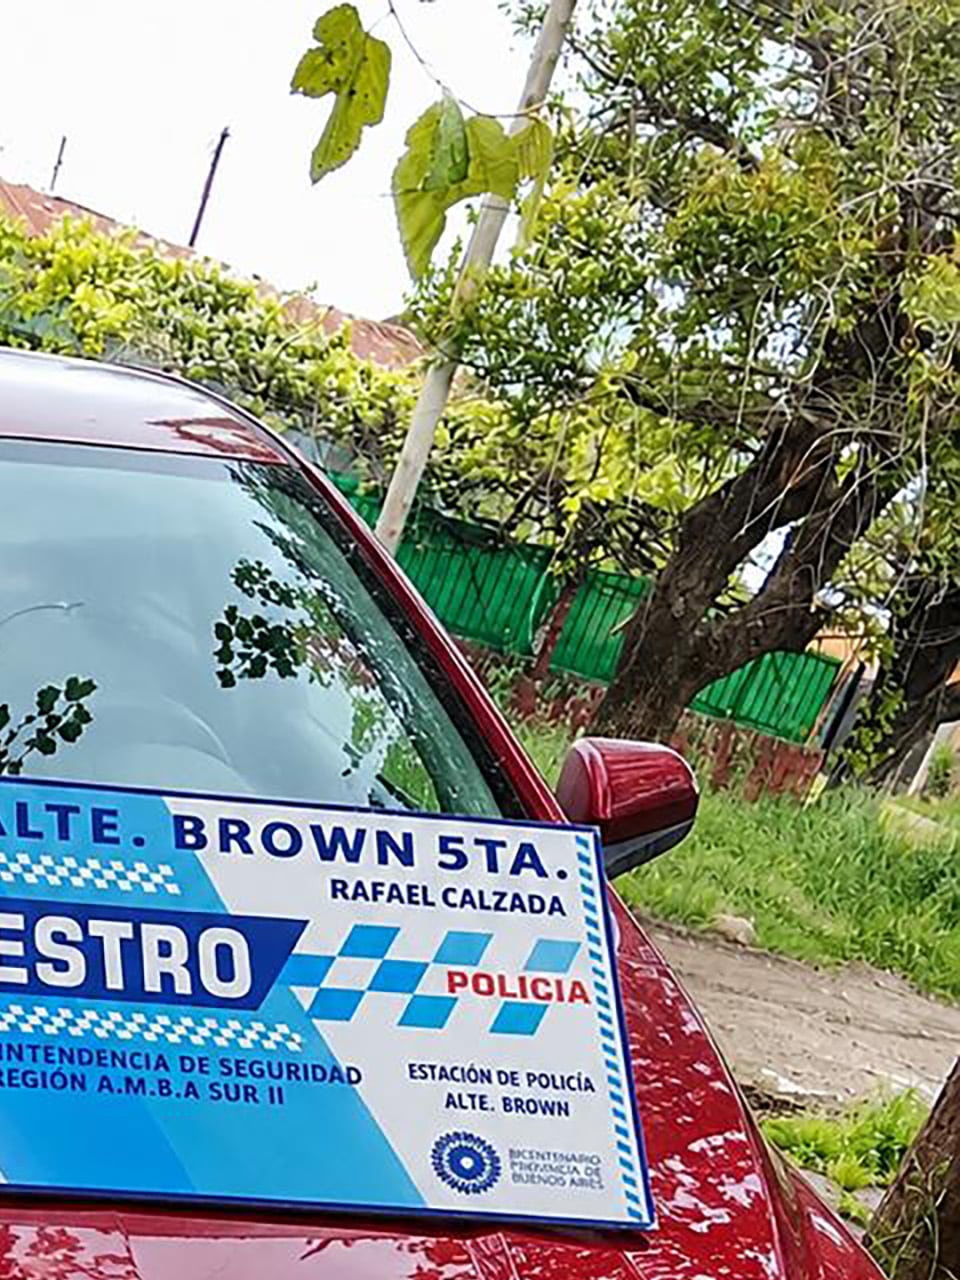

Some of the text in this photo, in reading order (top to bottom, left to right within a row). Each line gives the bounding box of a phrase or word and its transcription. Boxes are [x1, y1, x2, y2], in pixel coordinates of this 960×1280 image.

[172, 813, 415, 868] BROWN
[437, 835, 568, 880] 5TA.
[330, 878, 567, 917] RAFAEL CALZADA
[446, 970, 592, 1005] POLICIA
[179, 1055, 210, 1075] DE
[218, 1057, 363, 1085] SEGURIDAD
[408, 1063, 596, 1093] ESTACIÓN DE POLICÍA
[97, 1074, 200, 1100] A.M.B.A
[208, 1081, 260, 1105] SUR
[268, 1086, 285, 1105] II
[445, 1092, 570, 1117] ALTE. BROWN
